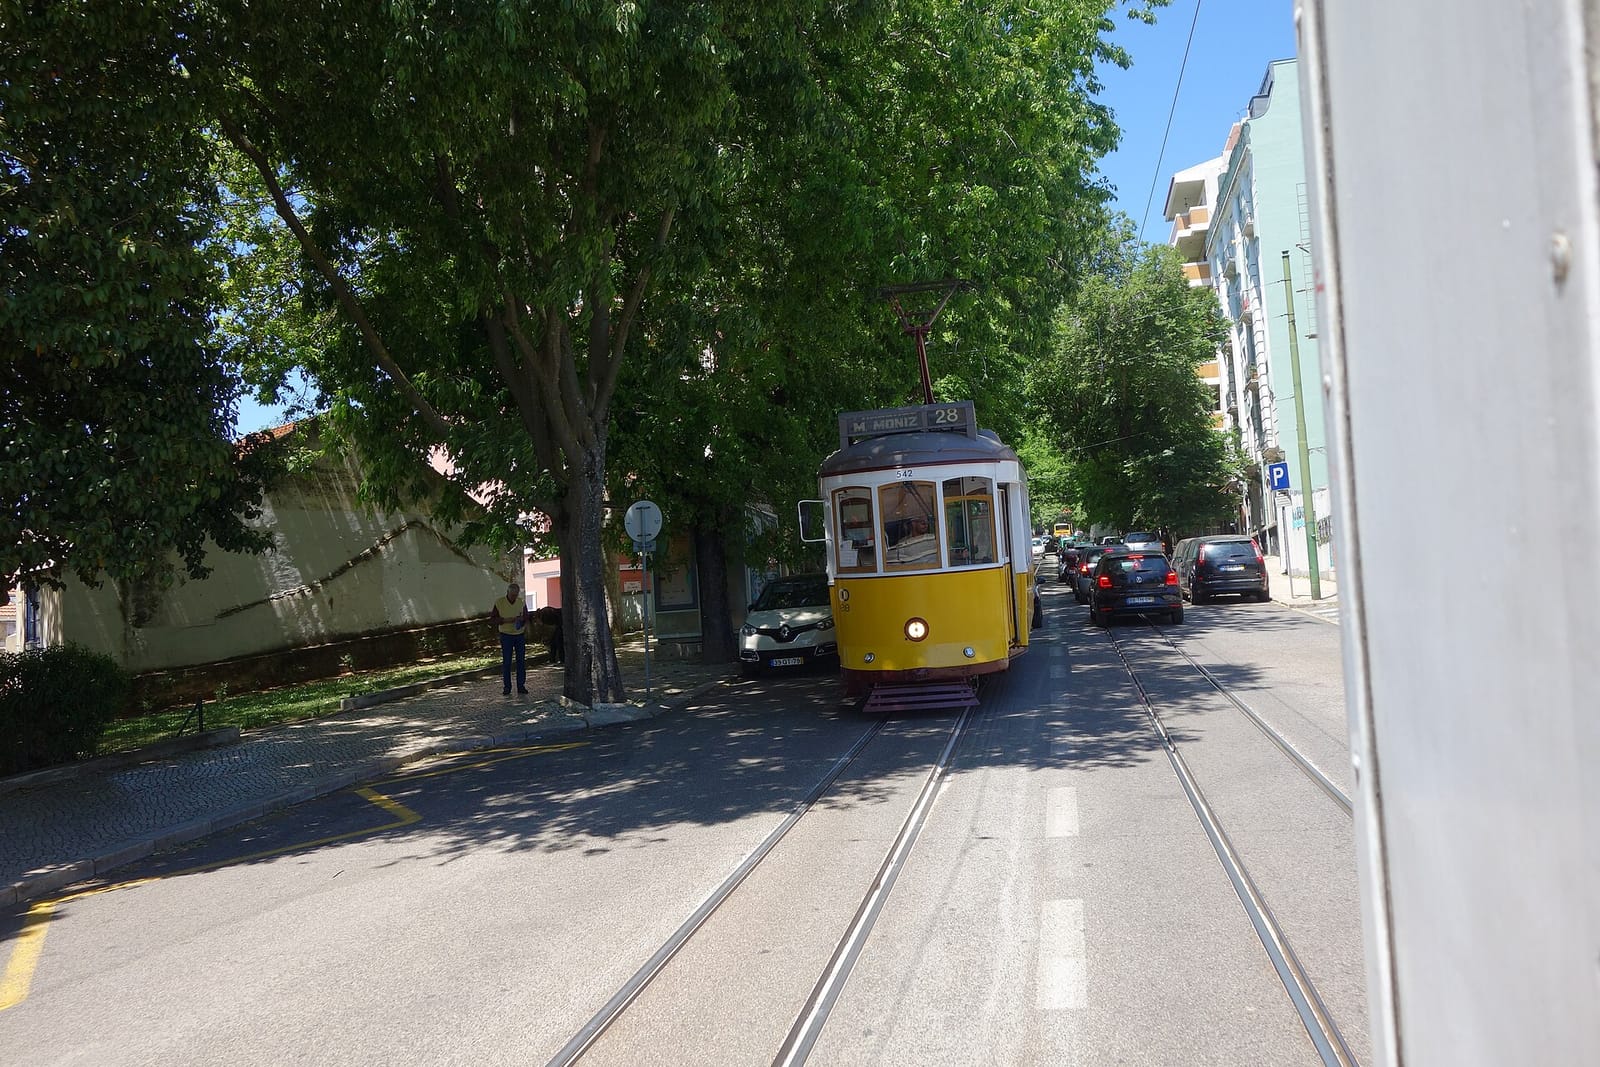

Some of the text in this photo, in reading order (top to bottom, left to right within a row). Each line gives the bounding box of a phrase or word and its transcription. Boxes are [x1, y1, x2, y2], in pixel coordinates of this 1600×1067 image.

[873, 416, 918, 430] MONIZ
[935, 408, 959, 424] 28
[896, 470, 913, 479] 542
[1273, 467, 1284, 487] P
